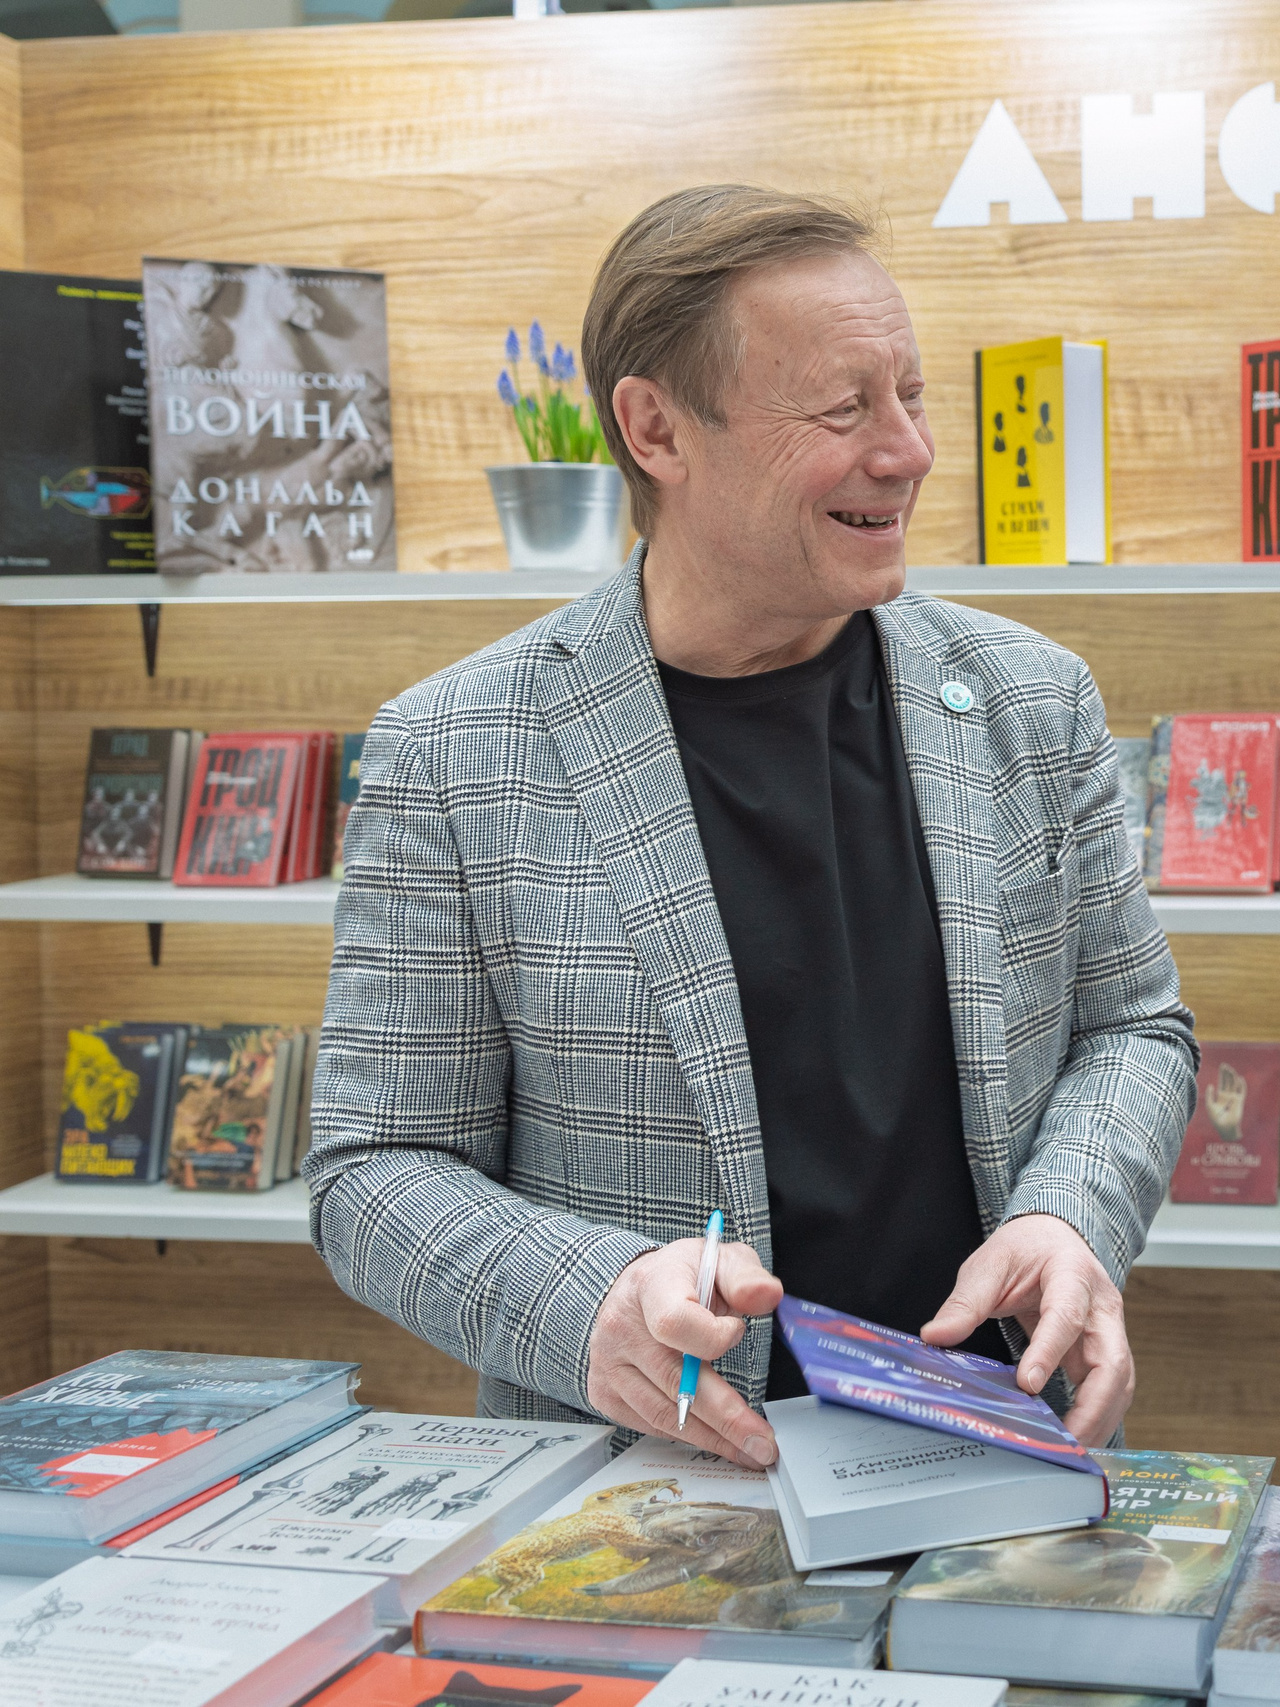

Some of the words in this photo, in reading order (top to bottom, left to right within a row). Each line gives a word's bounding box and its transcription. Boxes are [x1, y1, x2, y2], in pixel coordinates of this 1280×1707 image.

[166, 391, 371, 441] ВОЙНА
[169, 477, 375, 508] ДОНАЛЬД
[172, 510, 374, 540] КАГАН
[58, 1371, 145, 1390] КАК
[183, 1379, 259, 1388] АНДРЕЙ
[19, 1386, 169, 1409] ЖИВЫЕ
[409, 1421, 539, 1438] Первые
[413, 1433, 502, 1447] шаги
[641, 1463, 737, 1474] УВЛЕКАТЕЛЬНАЯ
[831, 1466, 847, 1475] Я
[836, 1450, 987, 1481] Путешествие
[690, 1472, 736, 1480] ГИБЕЛЬ
[907, 1472, 957, 1486] Андрей
[1119, 1469, 1182, 1480] ЙОНГ
[842, 1481, 904, 1497] Россохин
[1110, 1486, 1238, 1504] ЯТНЫЙ
[1109, 1498, 1152, 1510] ИР
[260, 1531, 343, 1542] Десильва
[271, 1523, 354, 1536] Джереми
[794, 1674, 875, 1690] КАК
